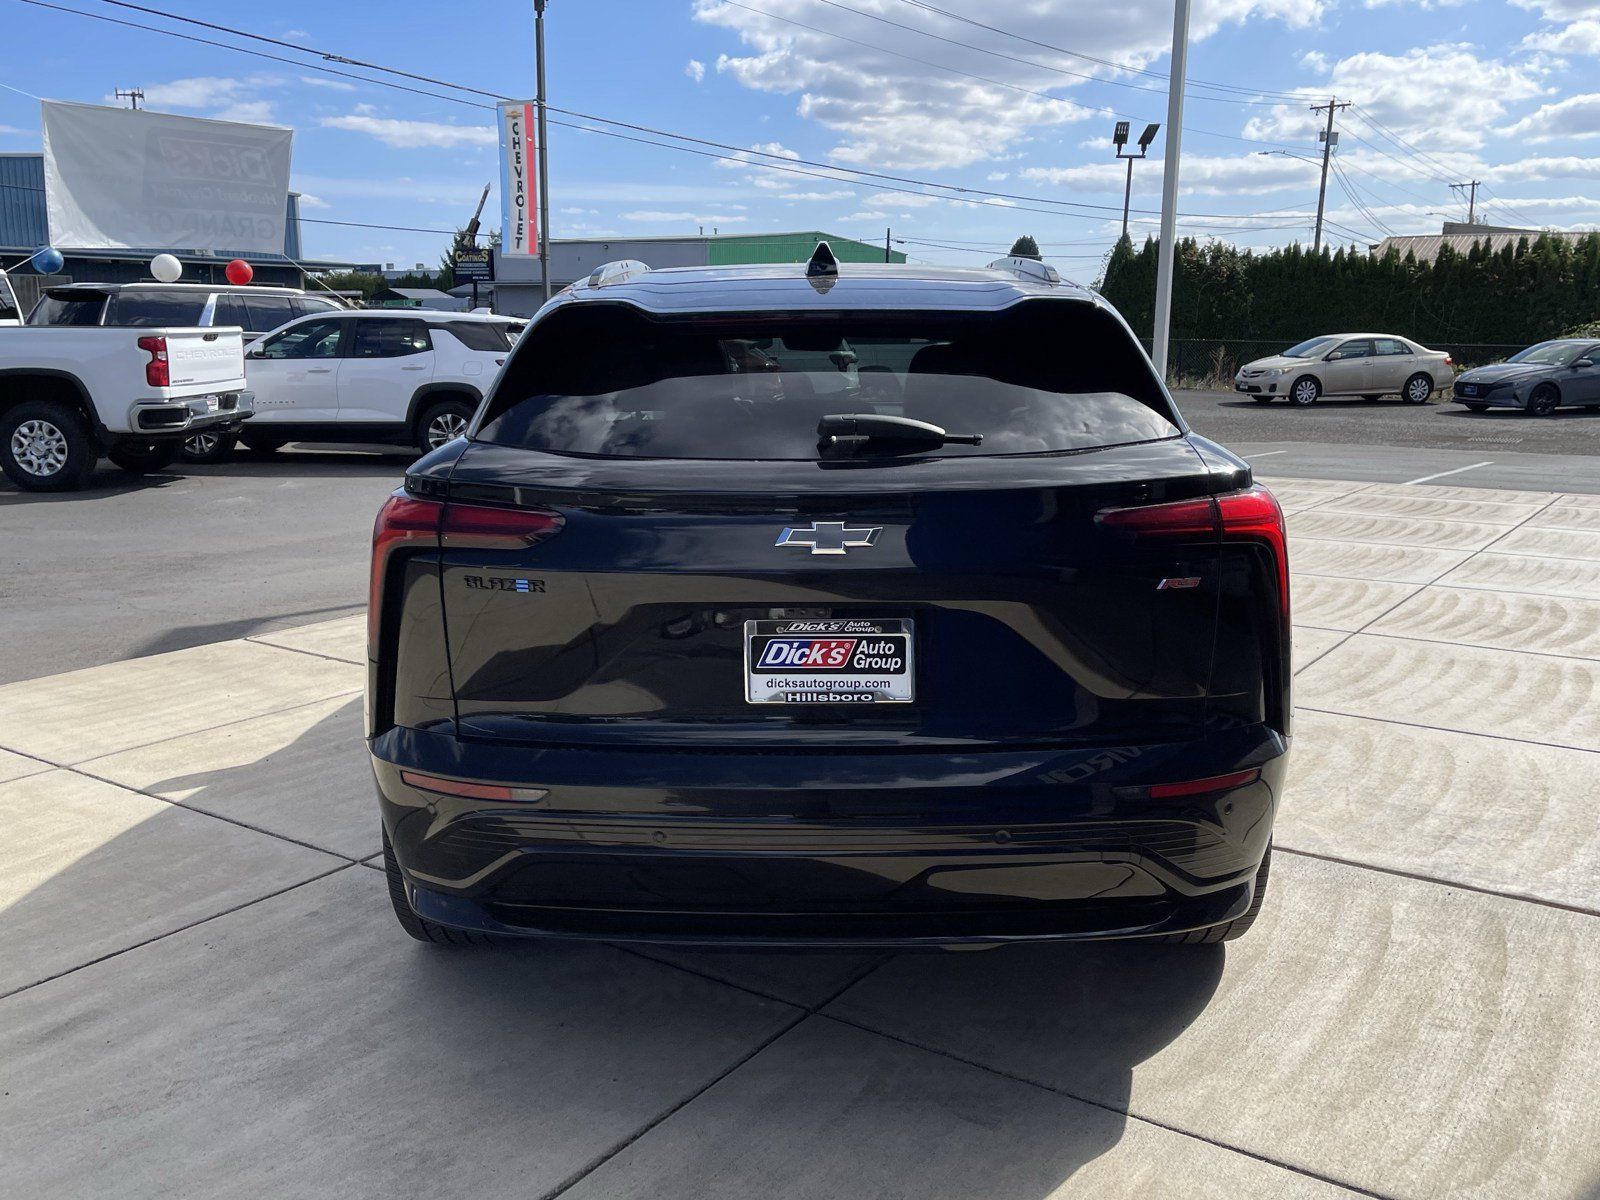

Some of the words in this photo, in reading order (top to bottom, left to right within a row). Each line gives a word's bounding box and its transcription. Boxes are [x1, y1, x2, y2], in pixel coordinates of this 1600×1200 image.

[511, 122, 525, 249] CHEVROLET
[855, 640, 895, 655] Auto
[853, 654, 902, 671] Group
[766, 678, 891, 690] dicksautogroup.com
[787, 692, 873, 702] Hillsboro
